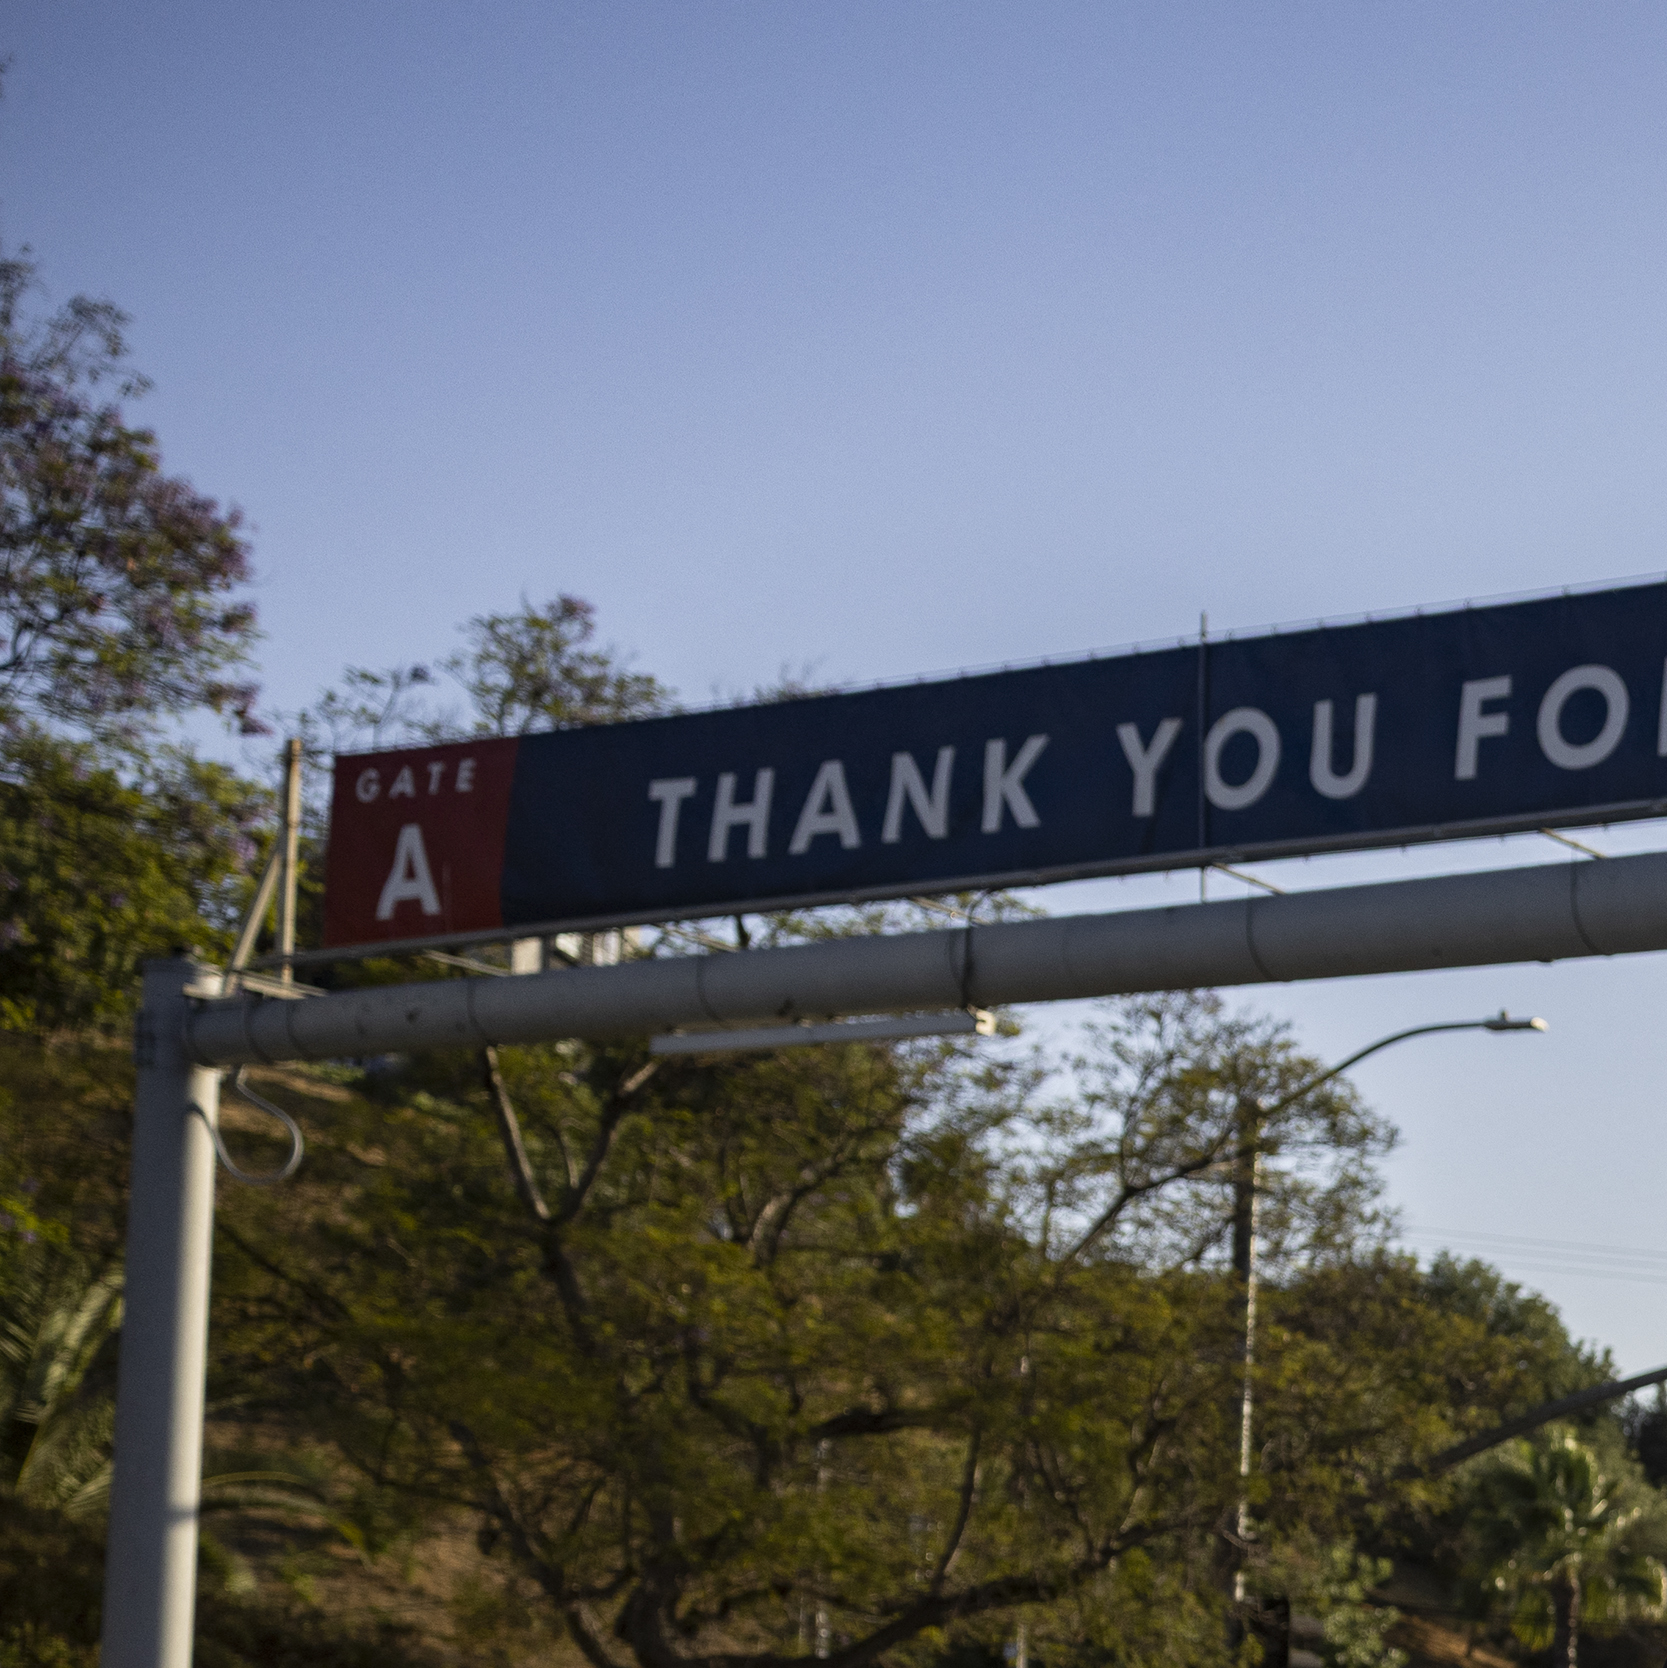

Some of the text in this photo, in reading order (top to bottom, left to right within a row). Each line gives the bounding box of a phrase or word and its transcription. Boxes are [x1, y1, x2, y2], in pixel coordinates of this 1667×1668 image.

[355, 758, 478, 802] GATE
[648, 733, 1049, 869] THANK
[1117, 692, 1377, 818] YOU
[374, 822, 440, 920] A
